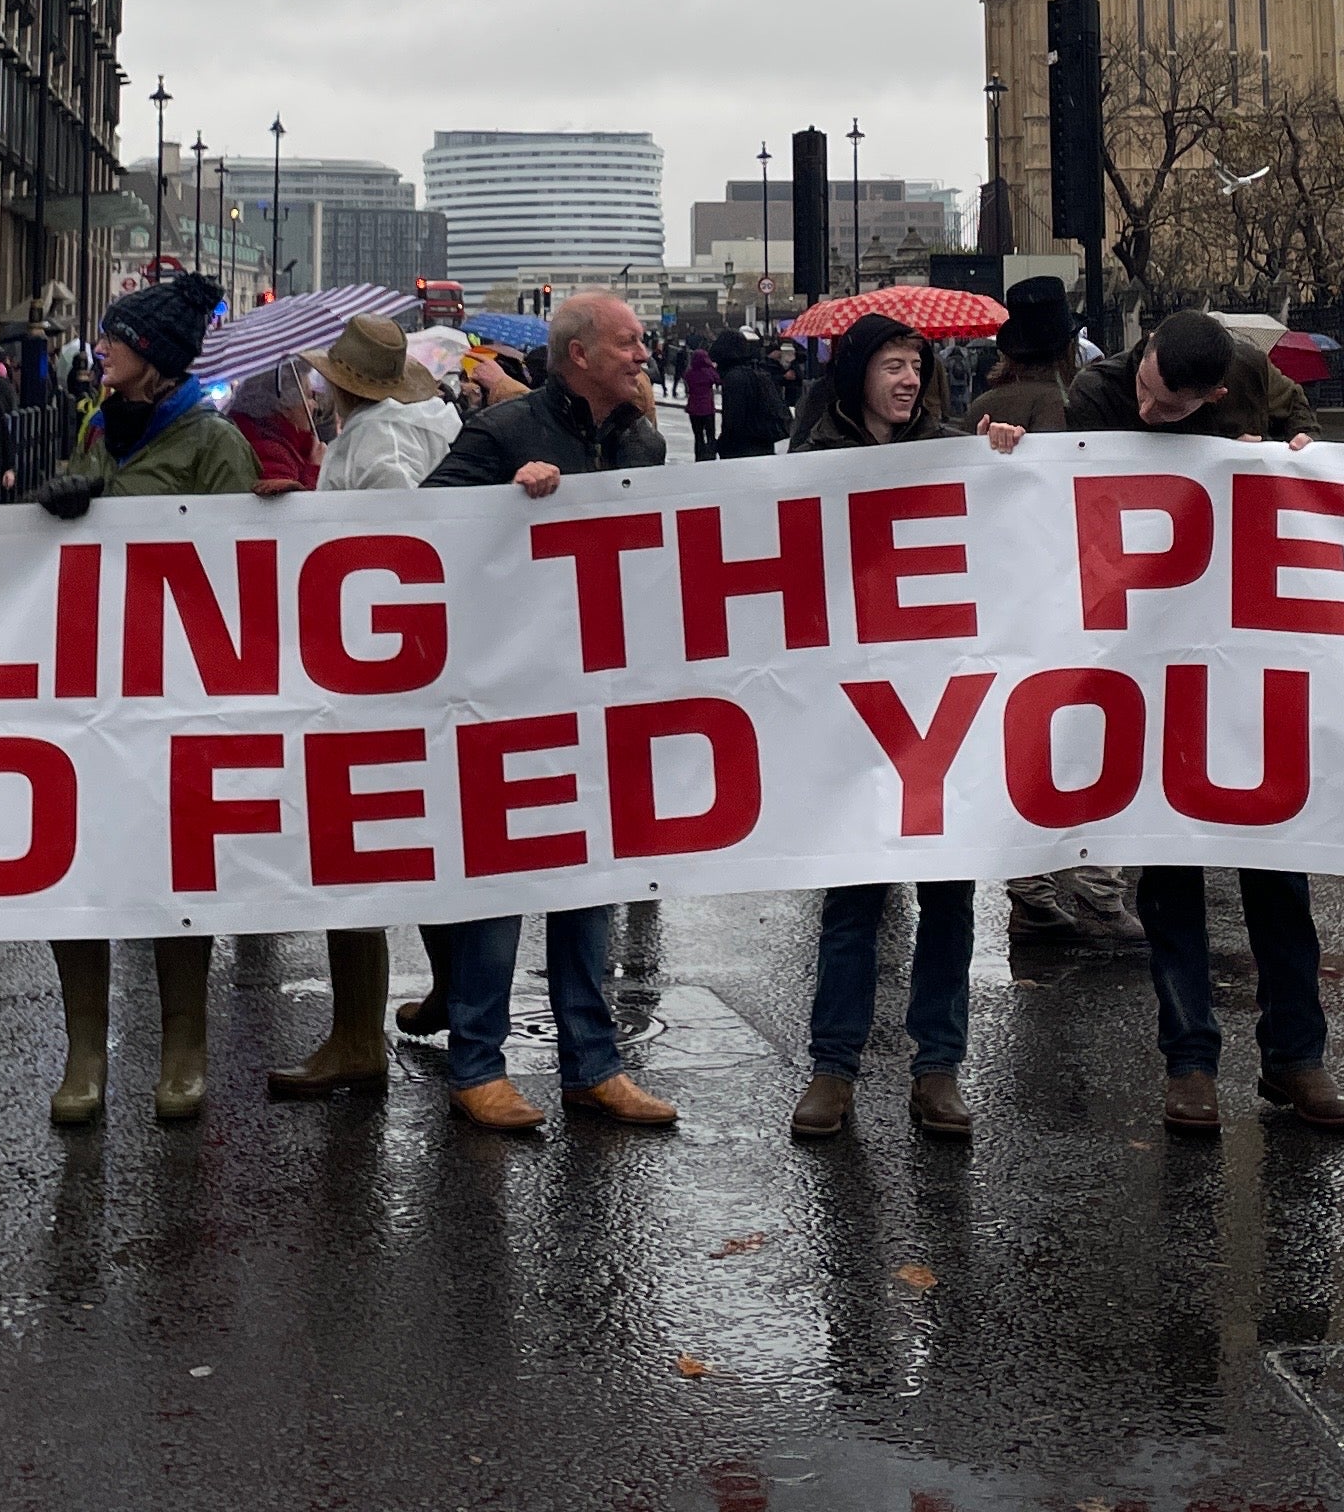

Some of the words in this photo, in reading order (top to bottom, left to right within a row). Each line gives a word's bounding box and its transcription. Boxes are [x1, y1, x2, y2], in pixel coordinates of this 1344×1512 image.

[531, 483, 976, 671] THE
[170, 697, 761, 891] FEED
[842, 664, 1309, 836] YOU
